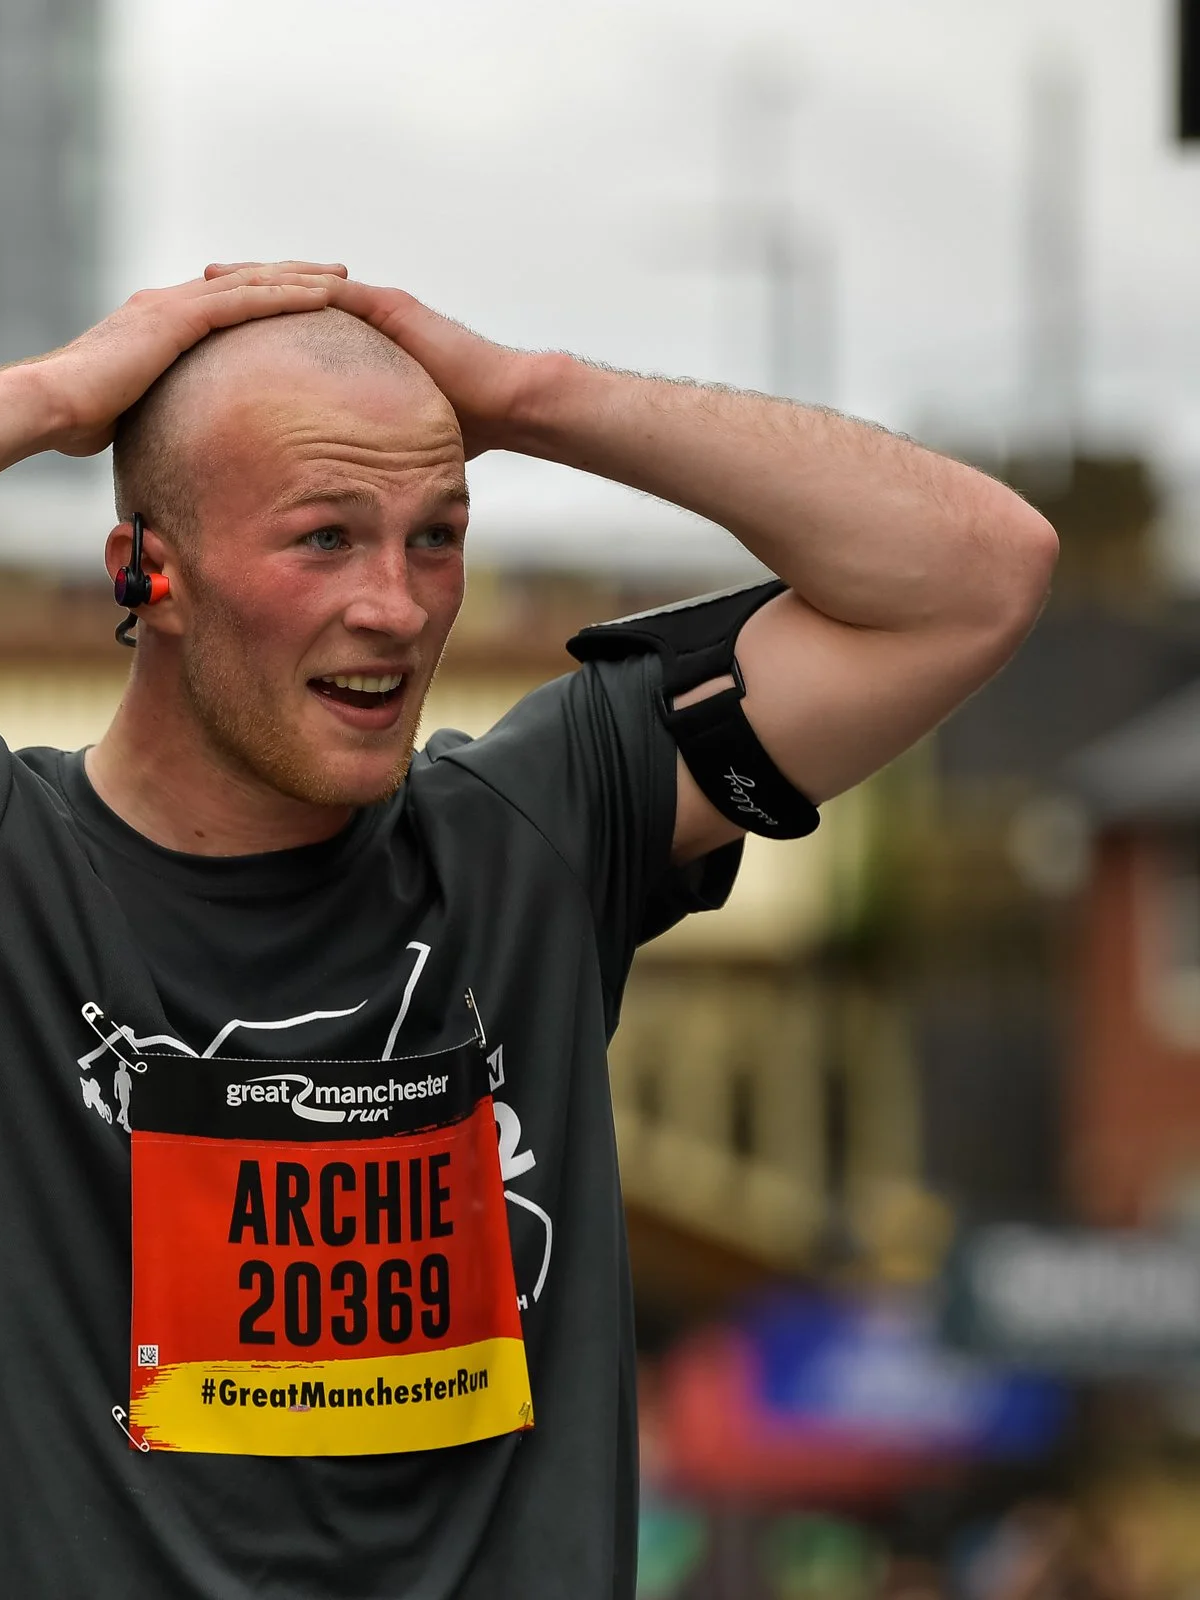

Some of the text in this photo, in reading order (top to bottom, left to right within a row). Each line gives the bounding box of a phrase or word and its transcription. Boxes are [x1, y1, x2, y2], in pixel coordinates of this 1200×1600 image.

[226, 1074, 449, 1107] great manchester
[347, 1107, 389, 1123] run
[228, 1152, 454, 1248] ARCHIE
[238, 1252, 451, 1348] 20369
[201, 1369, 489, 1409] #GreatManchesterRun
